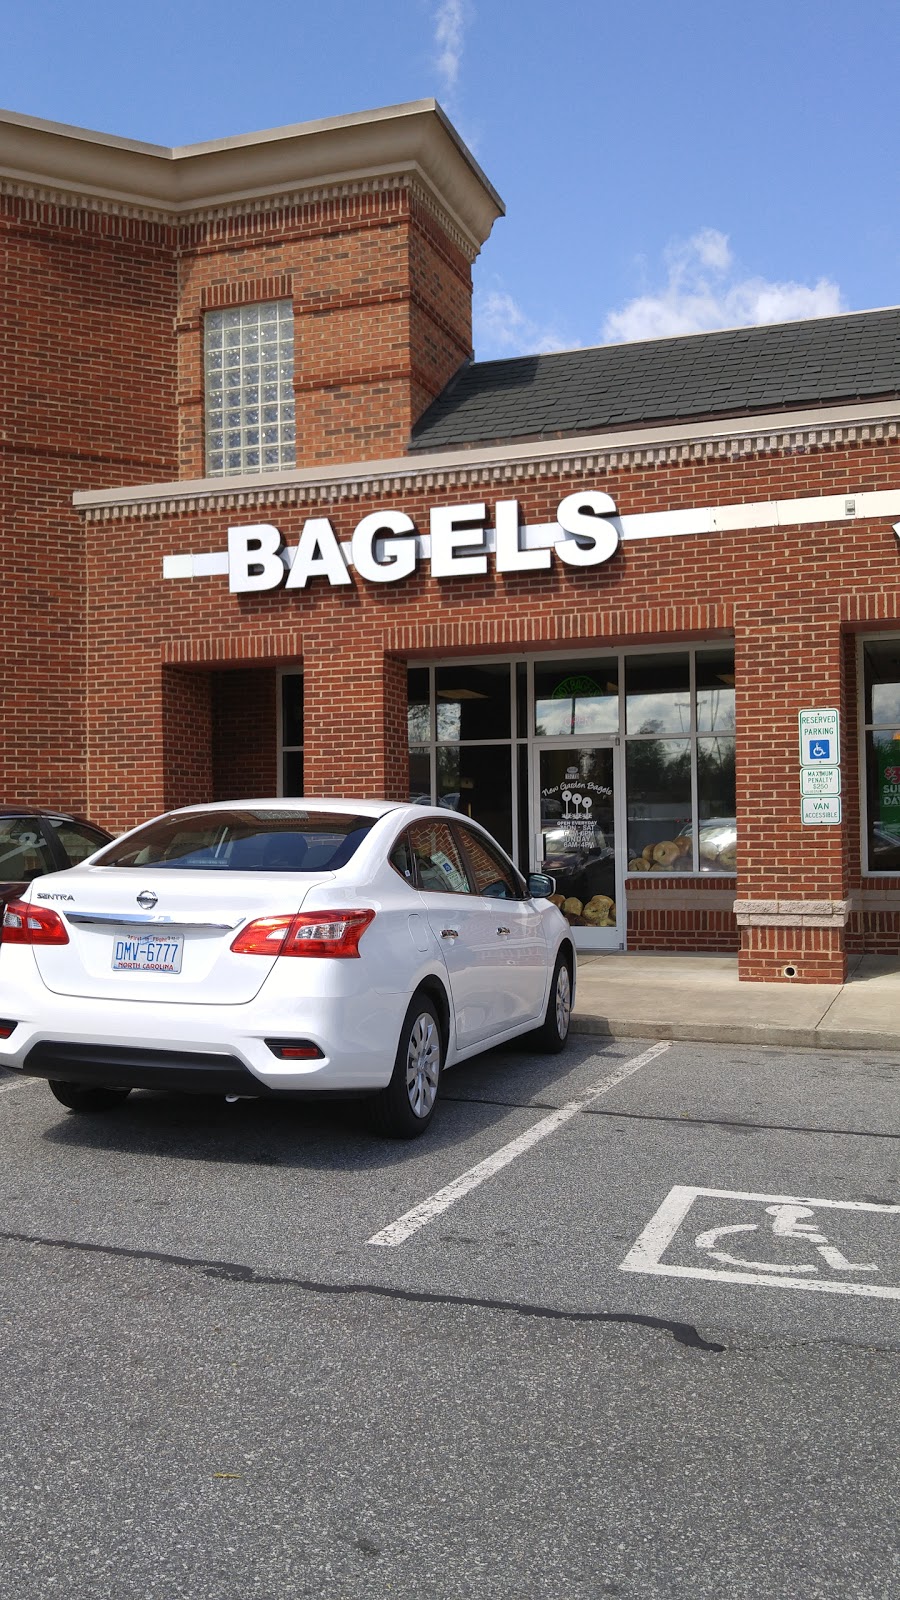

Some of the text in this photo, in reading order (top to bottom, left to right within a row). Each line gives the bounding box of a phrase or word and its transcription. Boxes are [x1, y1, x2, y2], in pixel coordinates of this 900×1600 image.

[227, 490, 618, 593] BAGELS
[802, 716, 836, 724] RESERVED
[541, 781, 613, 796] New Garden Bagels
[36, 892, 76, 901] SENTRA
[115, 941, 179, 962] DMV-6777
